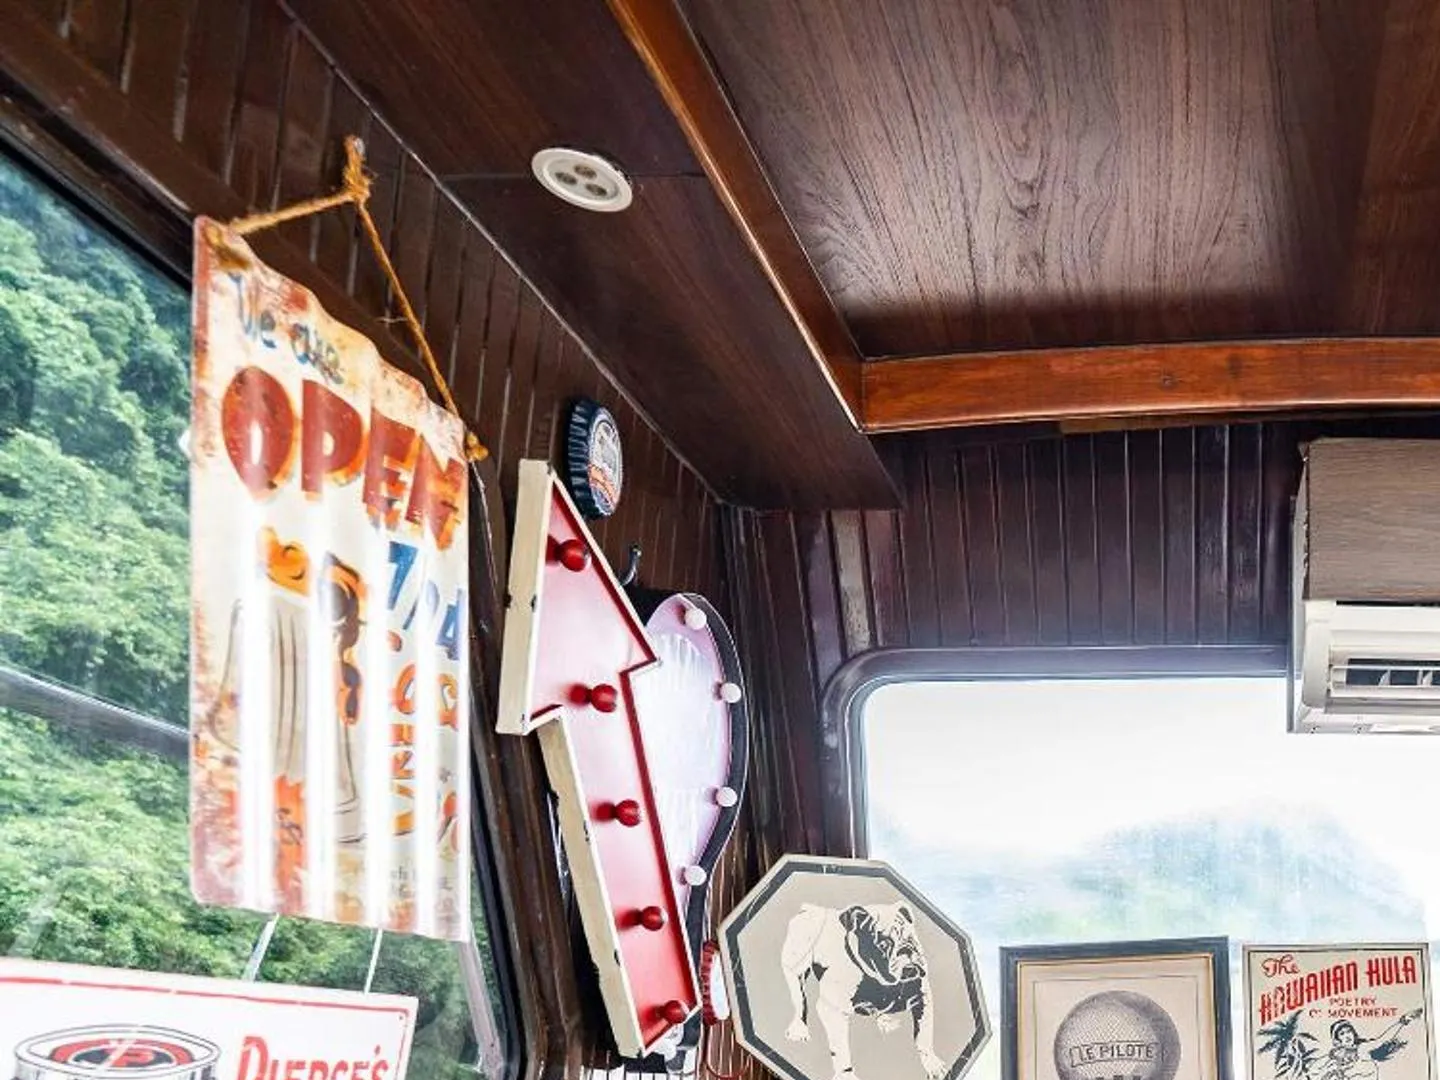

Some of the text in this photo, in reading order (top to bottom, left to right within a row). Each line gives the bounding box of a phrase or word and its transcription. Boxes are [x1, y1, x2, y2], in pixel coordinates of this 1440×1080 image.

[221, 365, 467, 552] OPEN
[1262, 954, 1300, 978] The
[1258, 955, 1417, 1026] HAWAIIAN HULA
[1328, 1007, 1399, 1019] MOVEMENT
[1099, 1043, 1154, 1060] PILOTE
